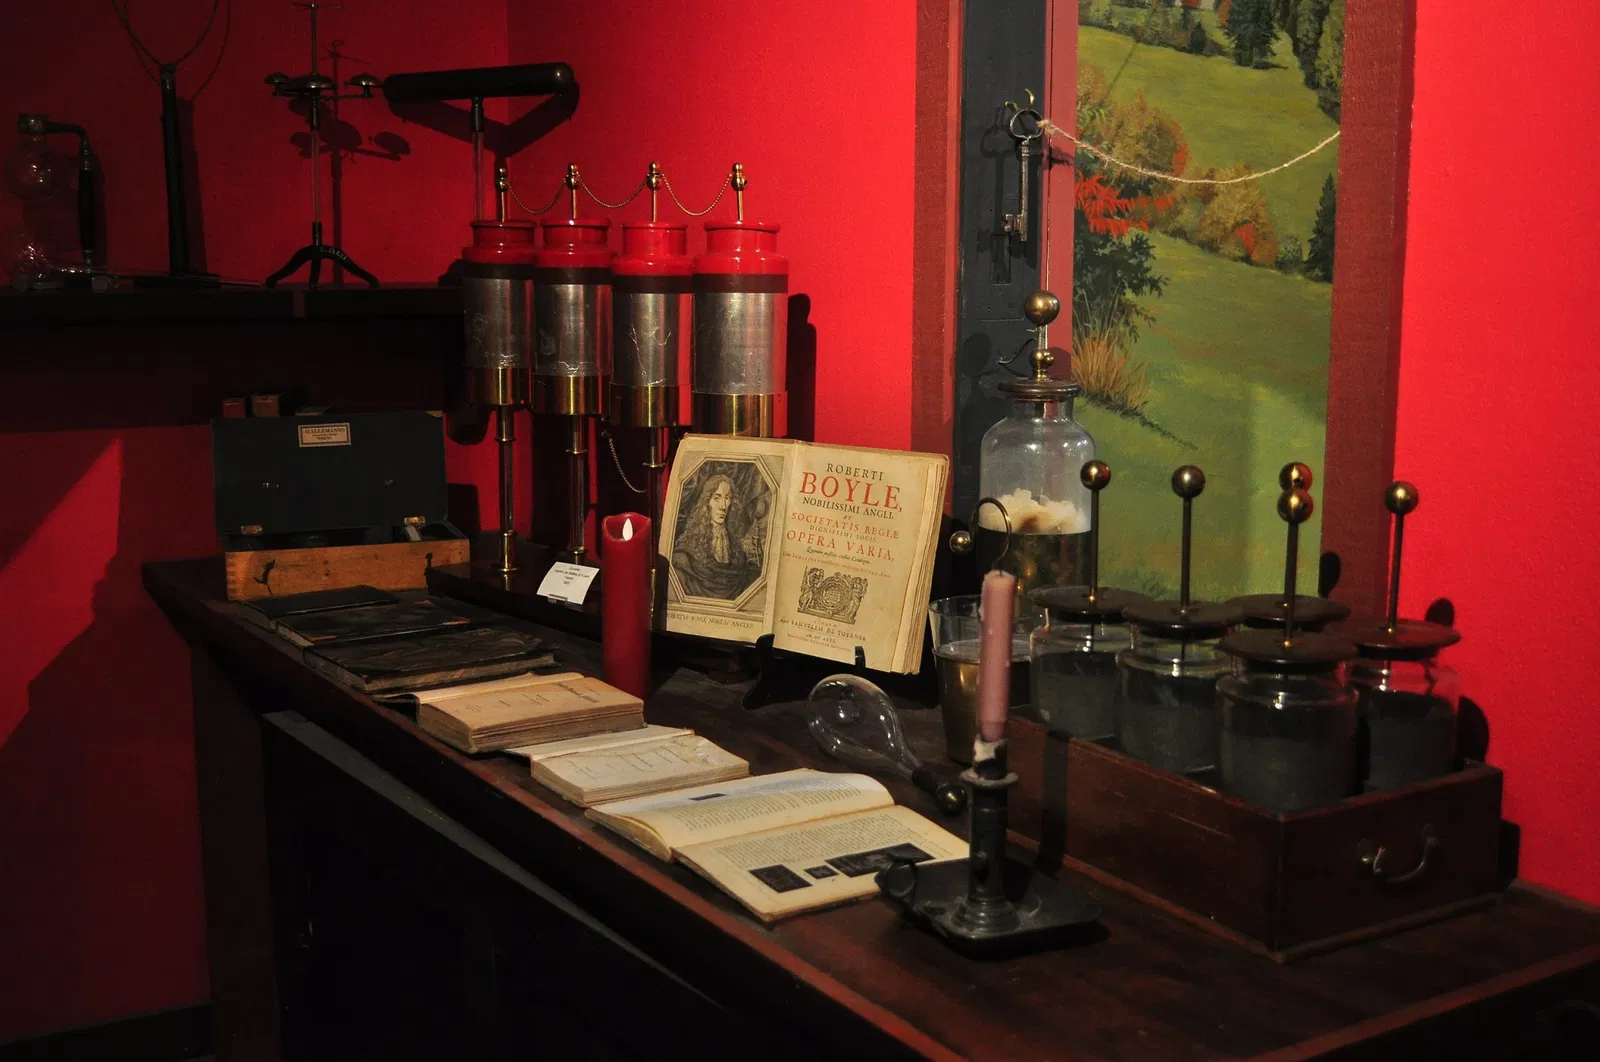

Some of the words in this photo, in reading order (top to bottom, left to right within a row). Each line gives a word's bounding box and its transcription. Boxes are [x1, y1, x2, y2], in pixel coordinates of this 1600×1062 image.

[826, 463, 884, 481] ROBERTI
[799, 472, 902, 512] BOYLE,
[802, 497, 860, 514] NOBILISSIMI
[791, 512, 860, 531] SOCIETATIS
[864, 525, 899, 539] REGIÆ
[809, 524, 852, 539] DIGNISSIMI
[786, 529, 836, 549] OPERA
[846, 541, 895, 562] VARIA,
